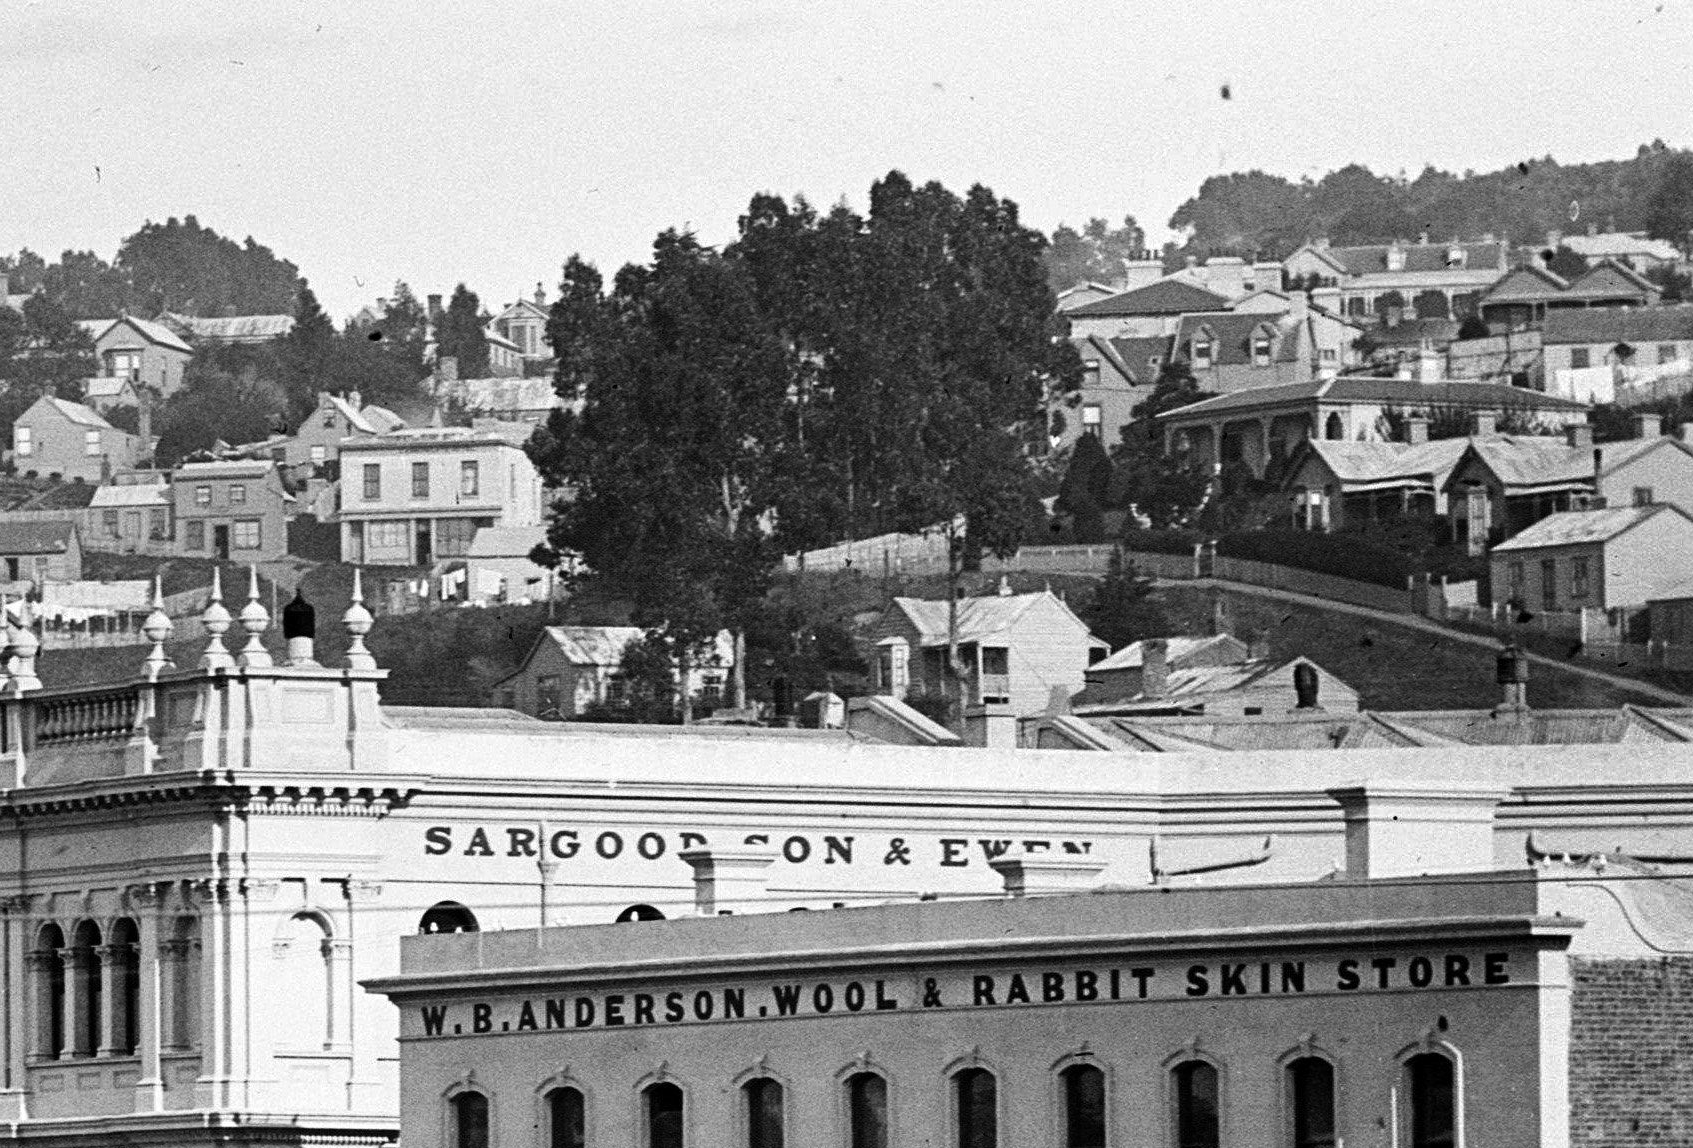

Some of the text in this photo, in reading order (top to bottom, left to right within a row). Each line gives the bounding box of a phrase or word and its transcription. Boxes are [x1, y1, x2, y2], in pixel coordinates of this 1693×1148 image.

[424, 826, 707, 860] SARGOOD
[884, 837, 912, 867] &
[922, 977, 944, 1009] &
[972, 967, 1155, 1006] RABBIT
[1185, 962, 1307, 998] SKIN
[1337, 952, 1510, 991] STORE
